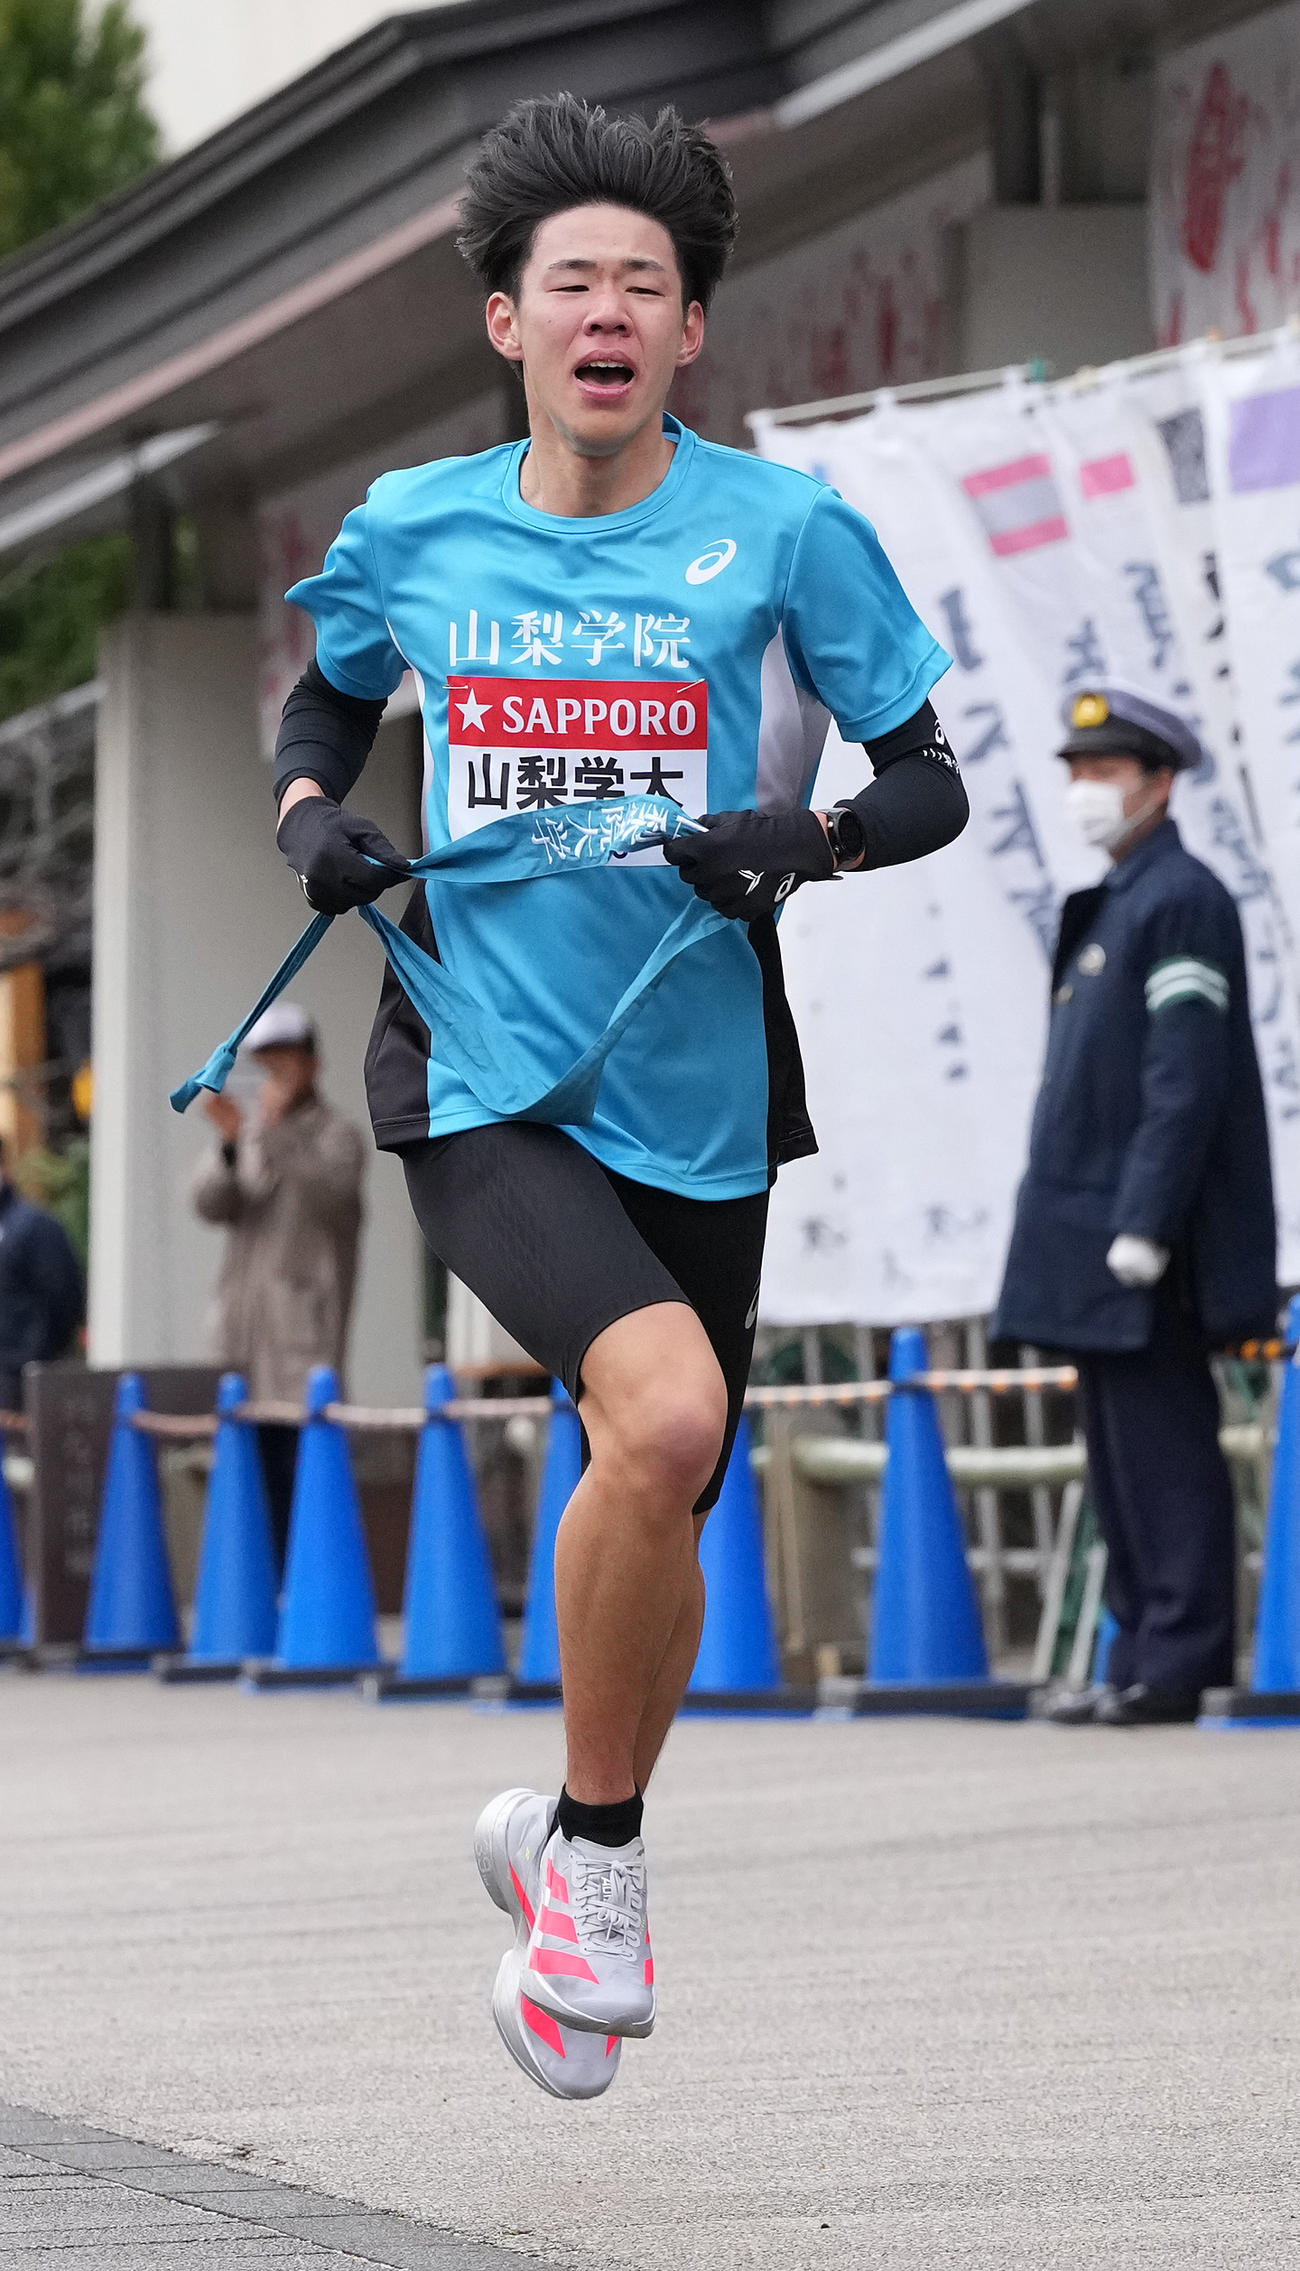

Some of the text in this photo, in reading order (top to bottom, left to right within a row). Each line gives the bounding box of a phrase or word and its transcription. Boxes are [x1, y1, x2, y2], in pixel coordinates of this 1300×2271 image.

[449, 609, 690, 668] 山梨学院
[502, 696, 696, 736] SAPPORO
[467, 753, 683, 810] 山梨学大
